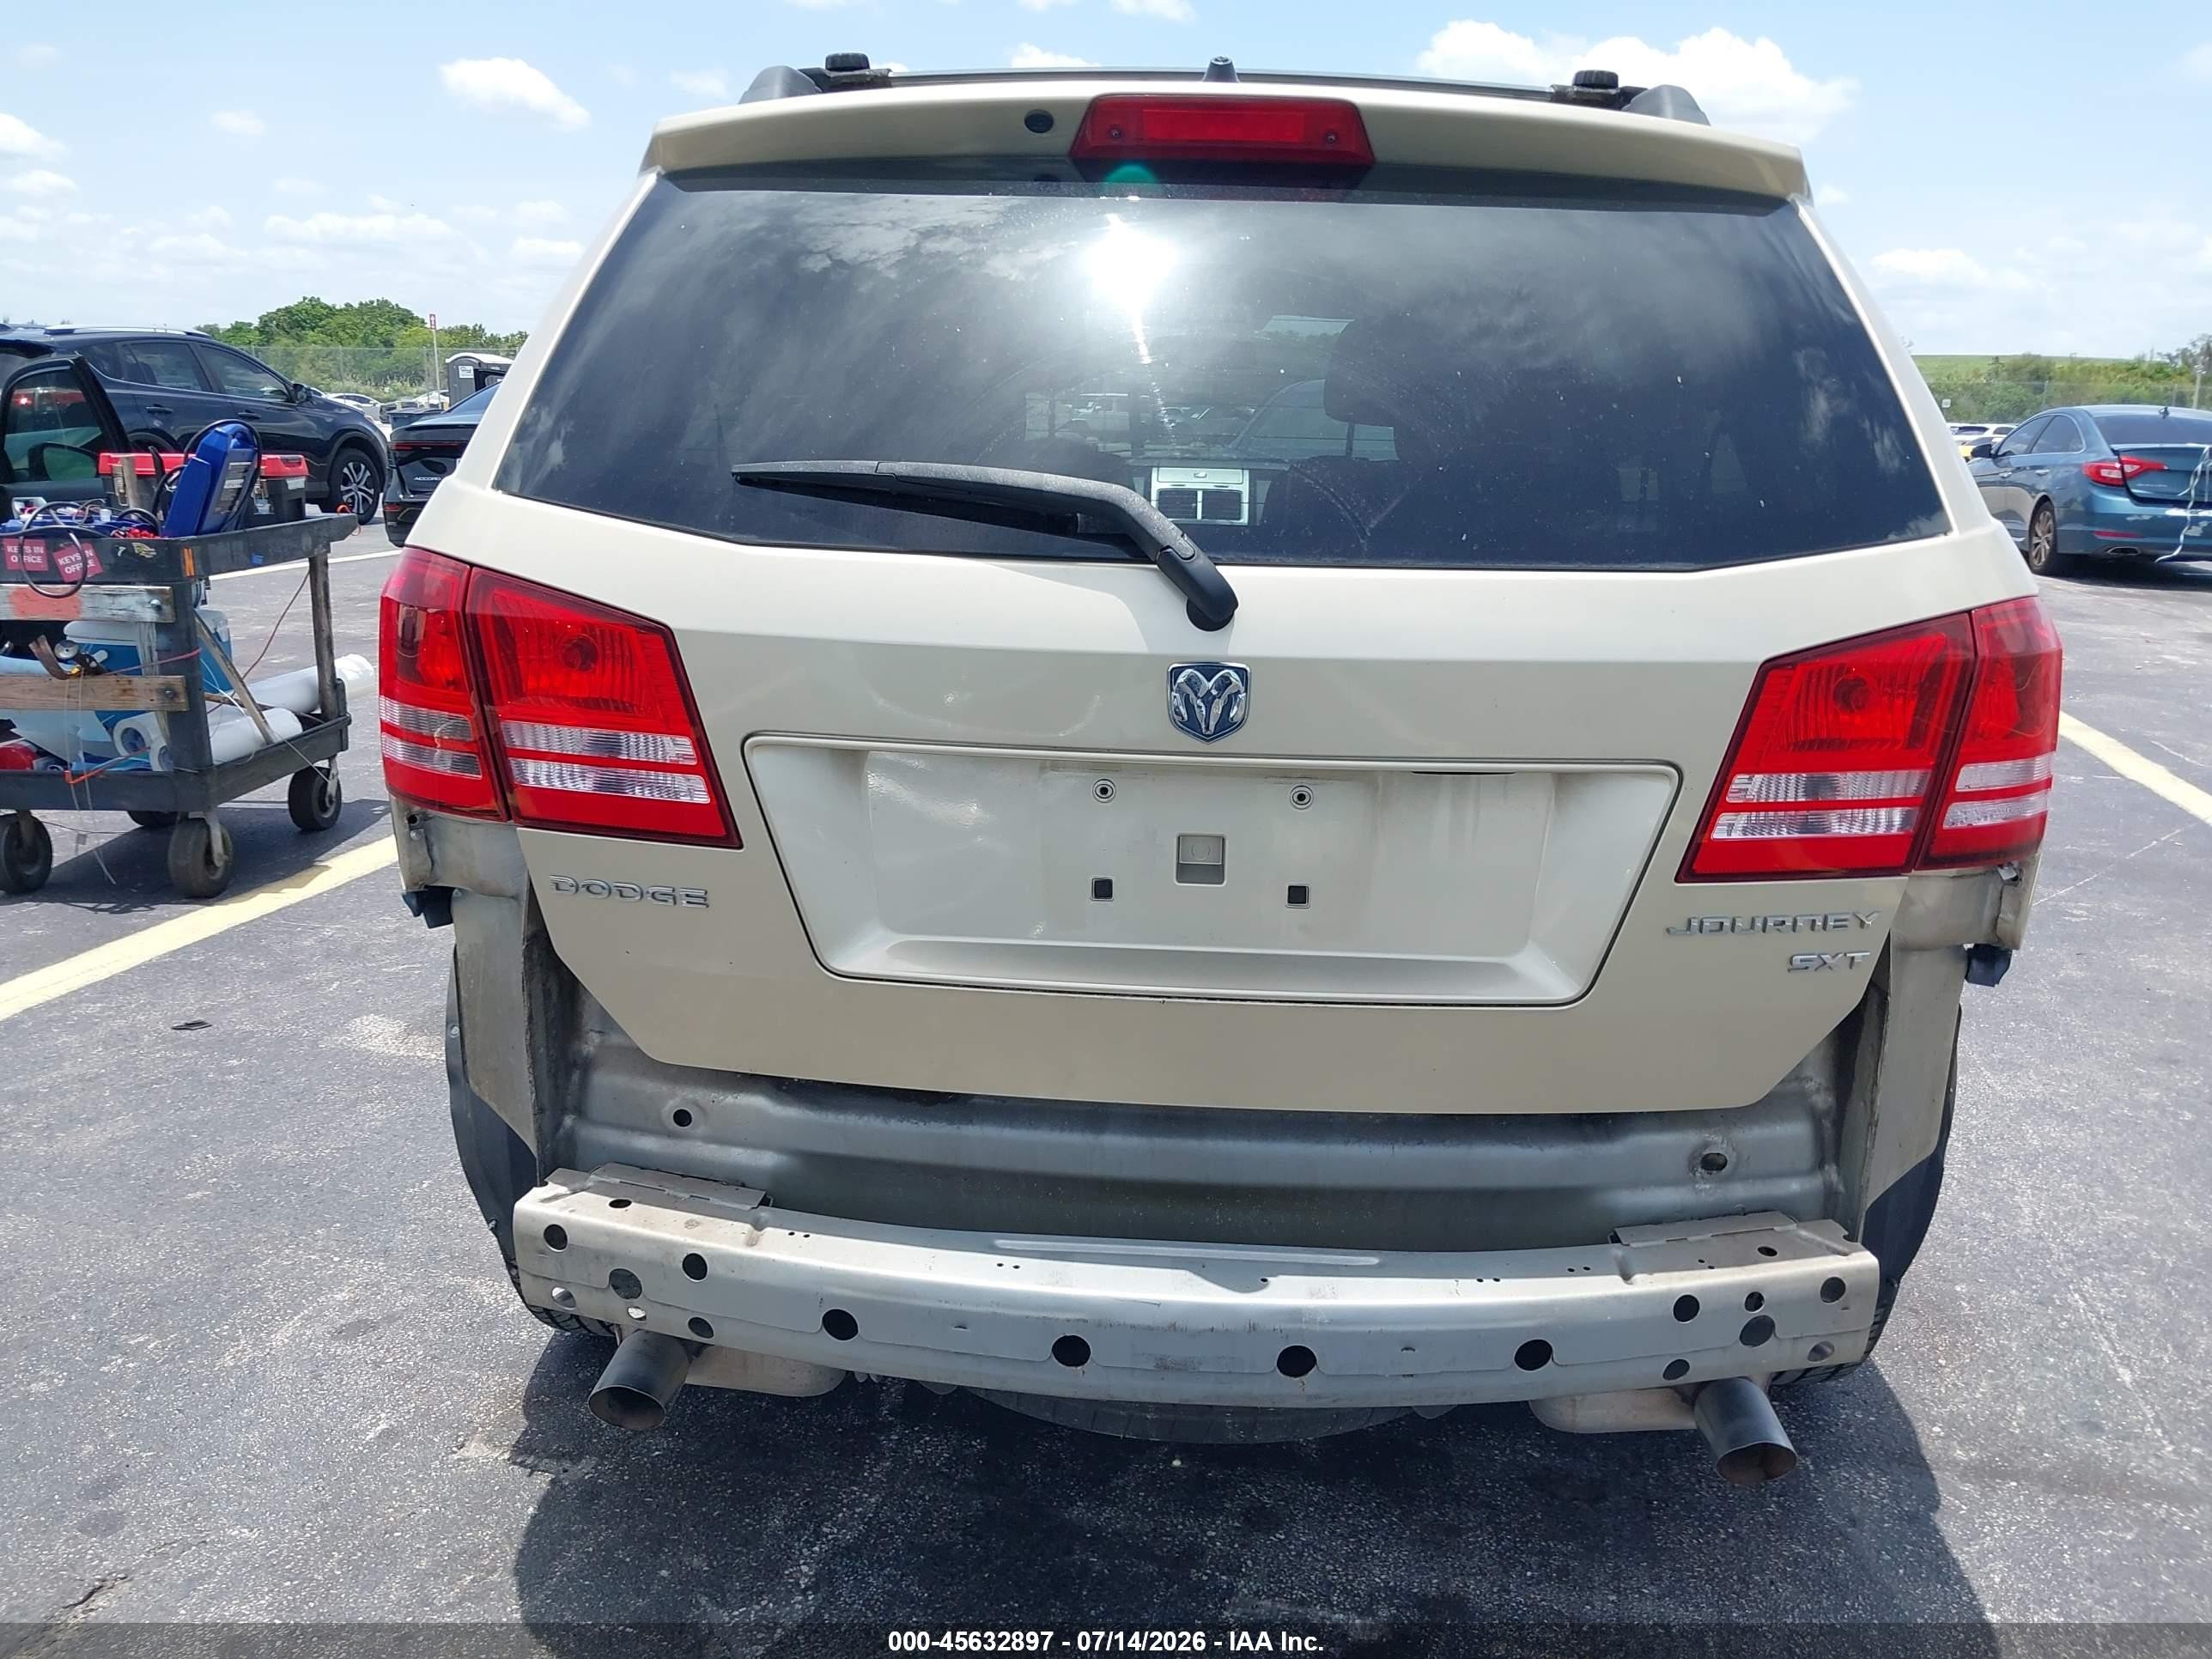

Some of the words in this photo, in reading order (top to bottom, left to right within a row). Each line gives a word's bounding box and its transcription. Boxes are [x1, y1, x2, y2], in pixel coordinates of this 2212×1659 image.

[10, 555, 43, 563] OFICE
[549, 875, 709, 908] DODGE
[1666, 910, 1882, 935] JOURNEY
[1787, 951, 1870, 973] SXT
